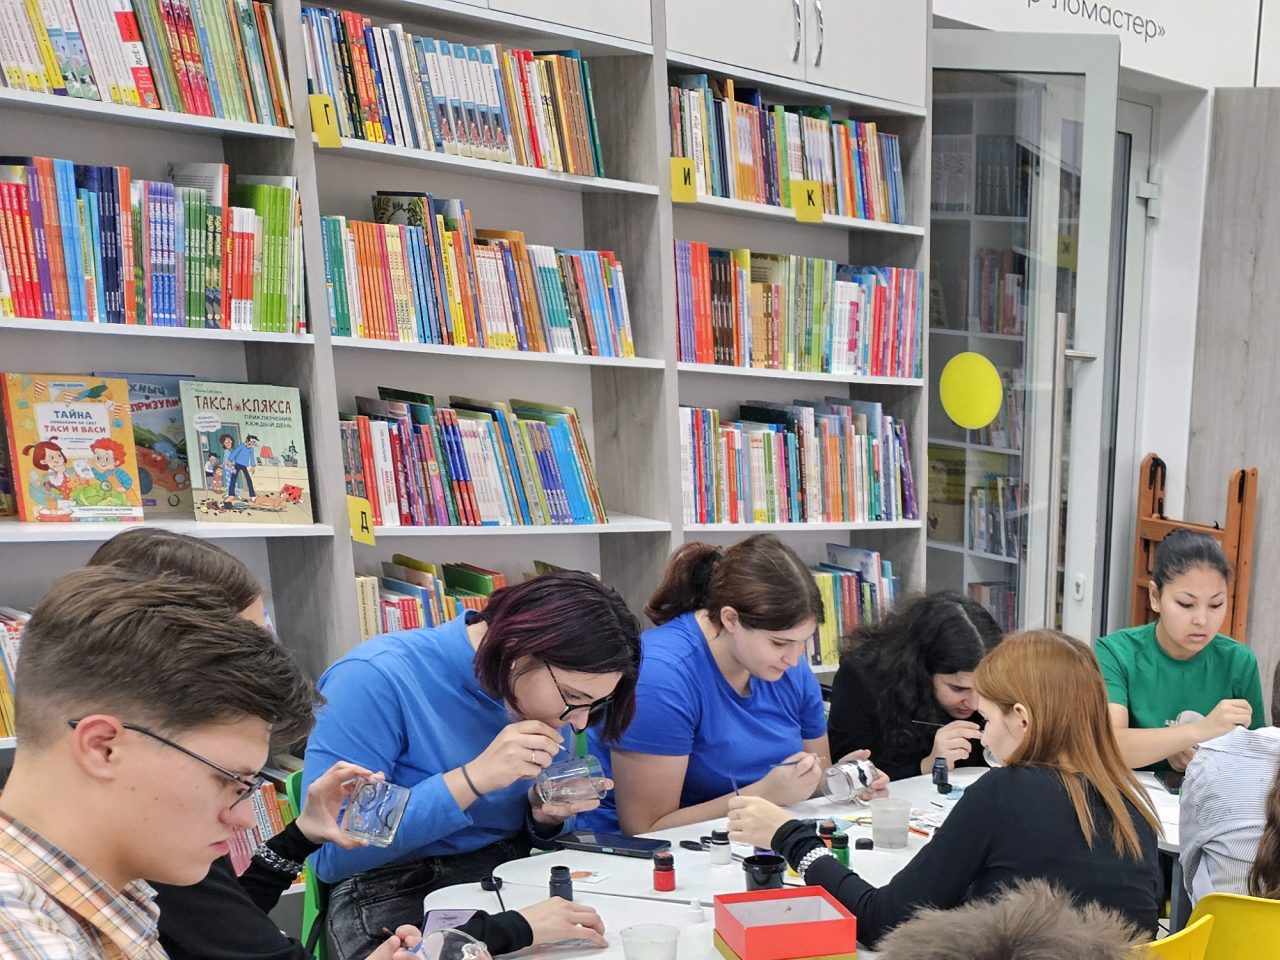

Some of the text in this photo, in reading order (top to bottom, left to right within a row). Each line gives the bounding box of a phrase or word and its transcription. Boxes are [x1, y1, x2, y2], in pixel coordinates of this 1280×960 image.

[683, 168, 691, 186] И
[807, 189, 815, 206] К
[194, 396, 291, 413] ТАКСА КЛЯКСА
[53, 409, 92, 419] ТАЙНА
[361, 511, 369, 533] Д
